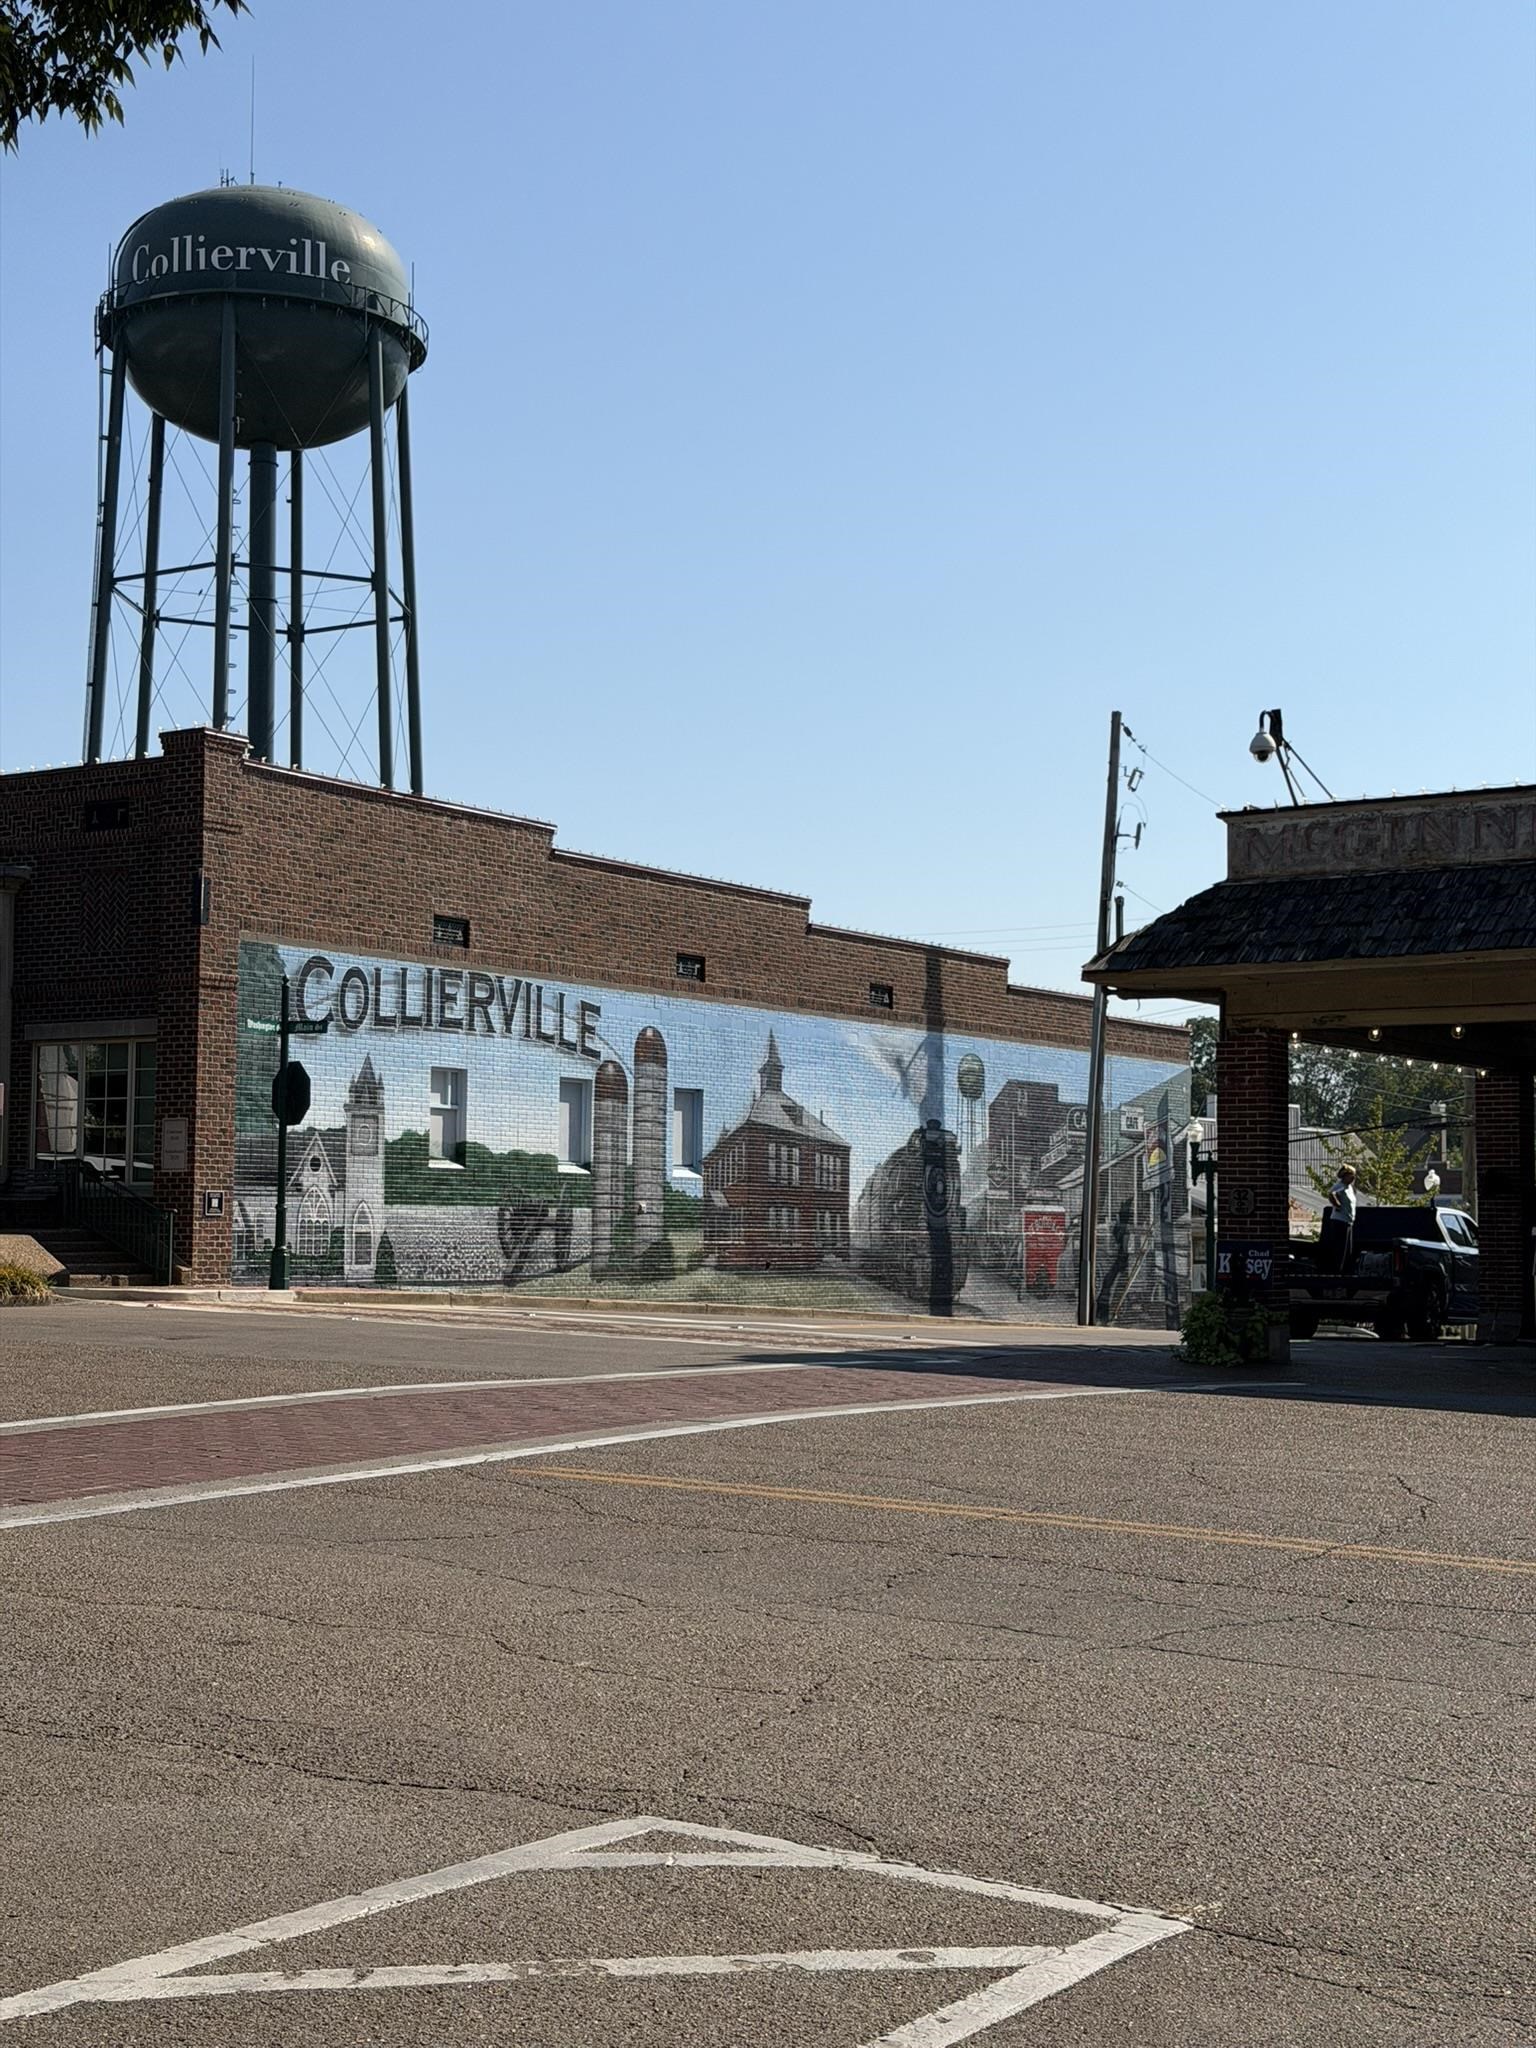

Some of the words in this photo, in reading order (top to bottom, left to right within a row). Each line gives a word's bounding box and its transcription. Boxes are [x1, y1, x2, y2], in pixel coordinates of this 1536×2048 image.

[132, 235, 351, 284] Collierville
[297, 955, 600, 1059] COLLIERVILLE
[1218, 1253, 1273, 1280] Ksey
[1248, 1249, 1270, 1257] Chad
